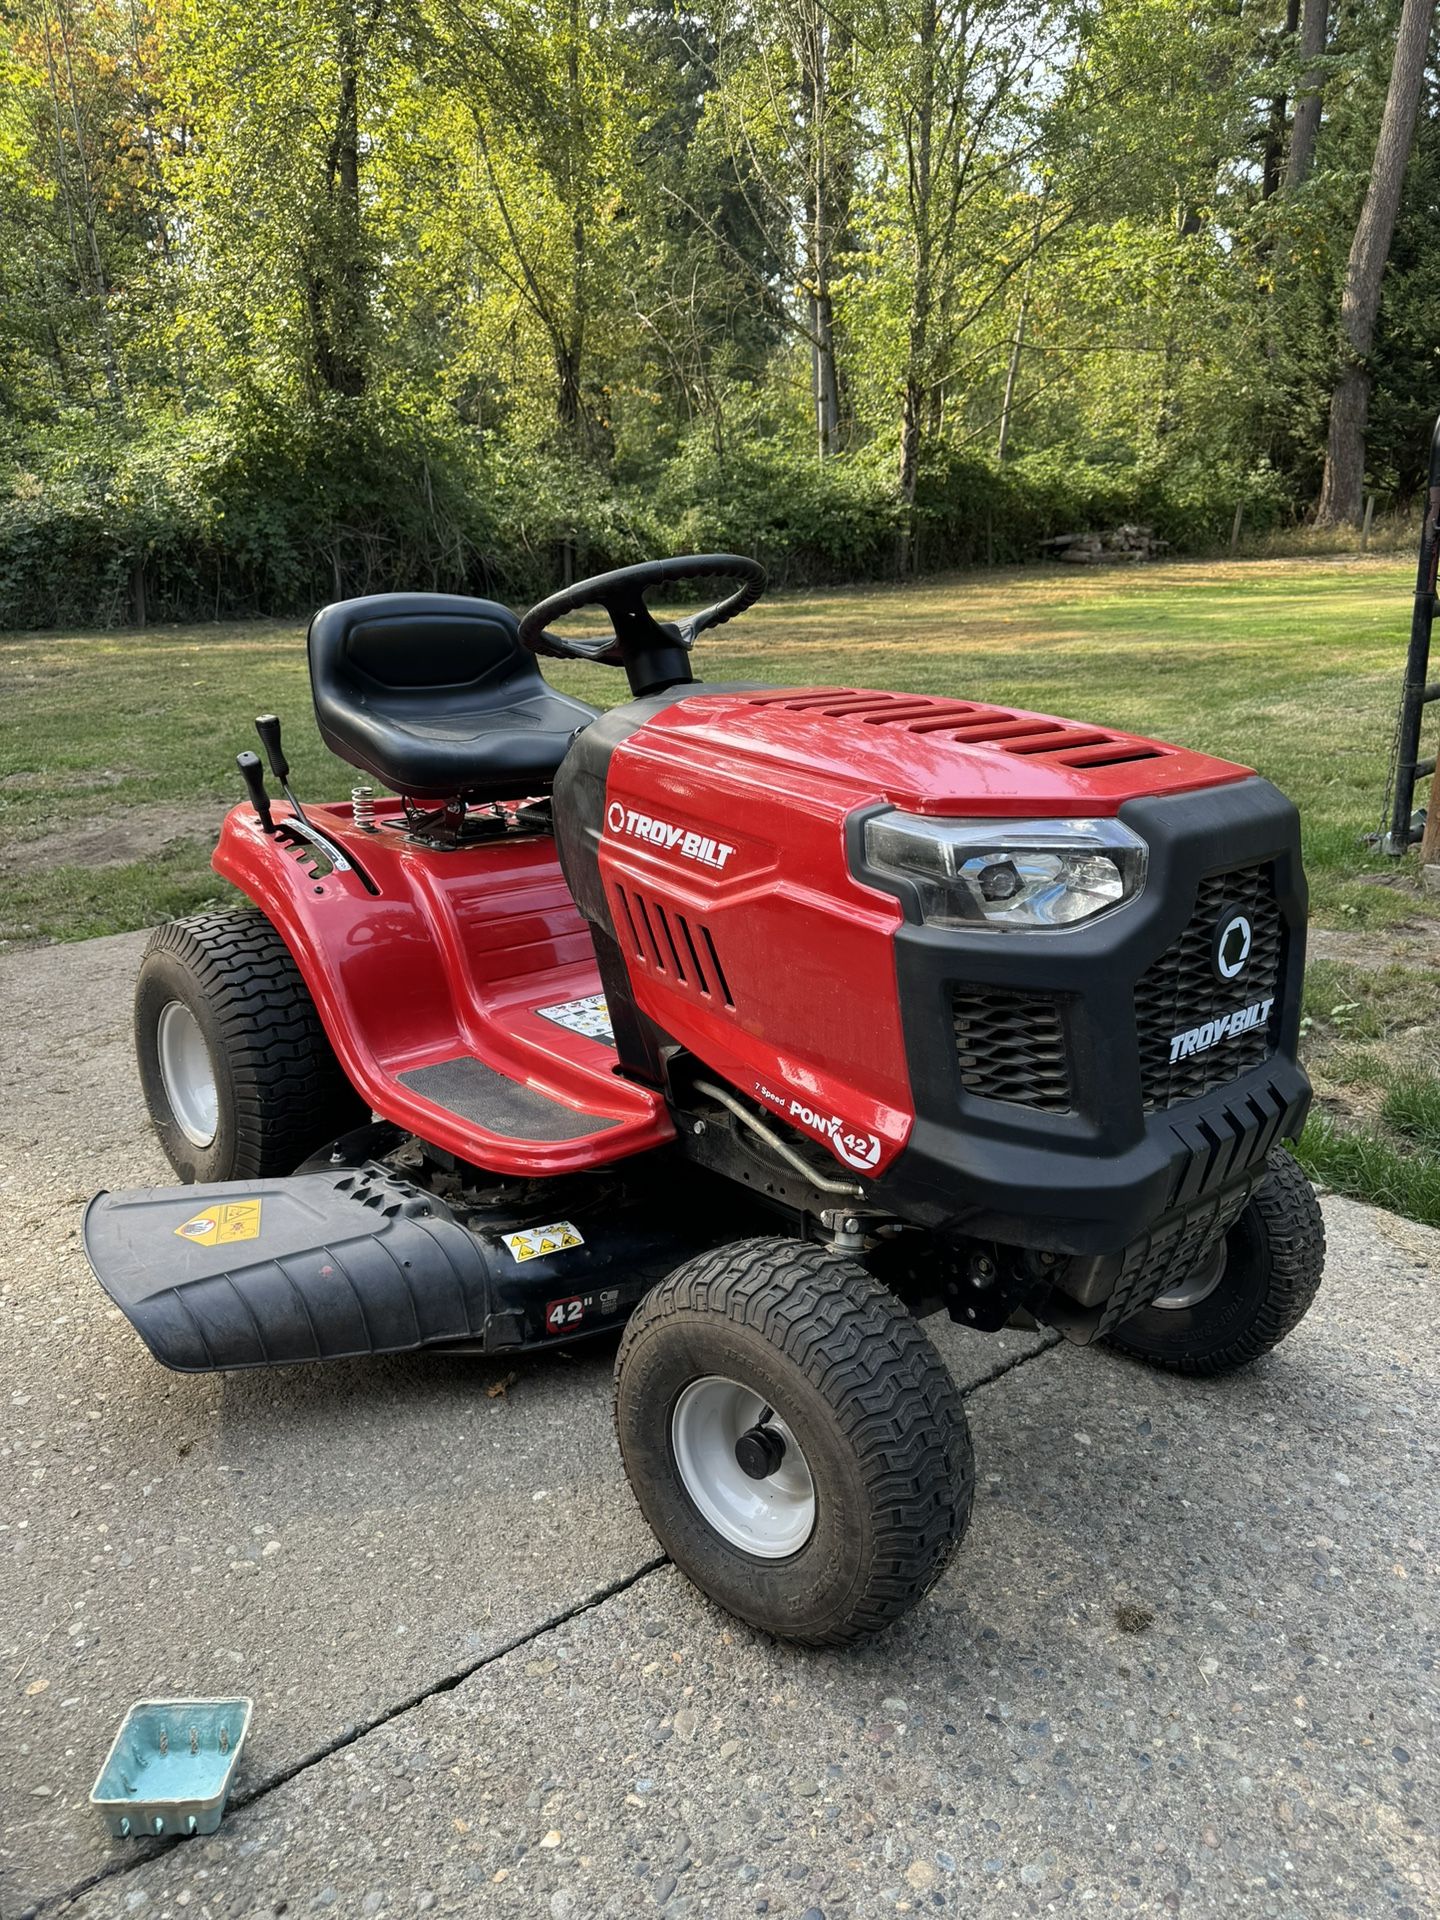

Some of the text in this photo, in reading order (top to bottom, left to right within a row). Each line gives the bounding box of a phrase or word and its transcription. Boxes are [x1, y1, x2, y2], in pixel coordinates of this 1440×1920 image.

[625, 810, 734, 870] TROY-BILT
[1169, 998, 1275, 1065] TROY-BILT
[754, 1082, 868, 1155] 7 Speed PONY 42
